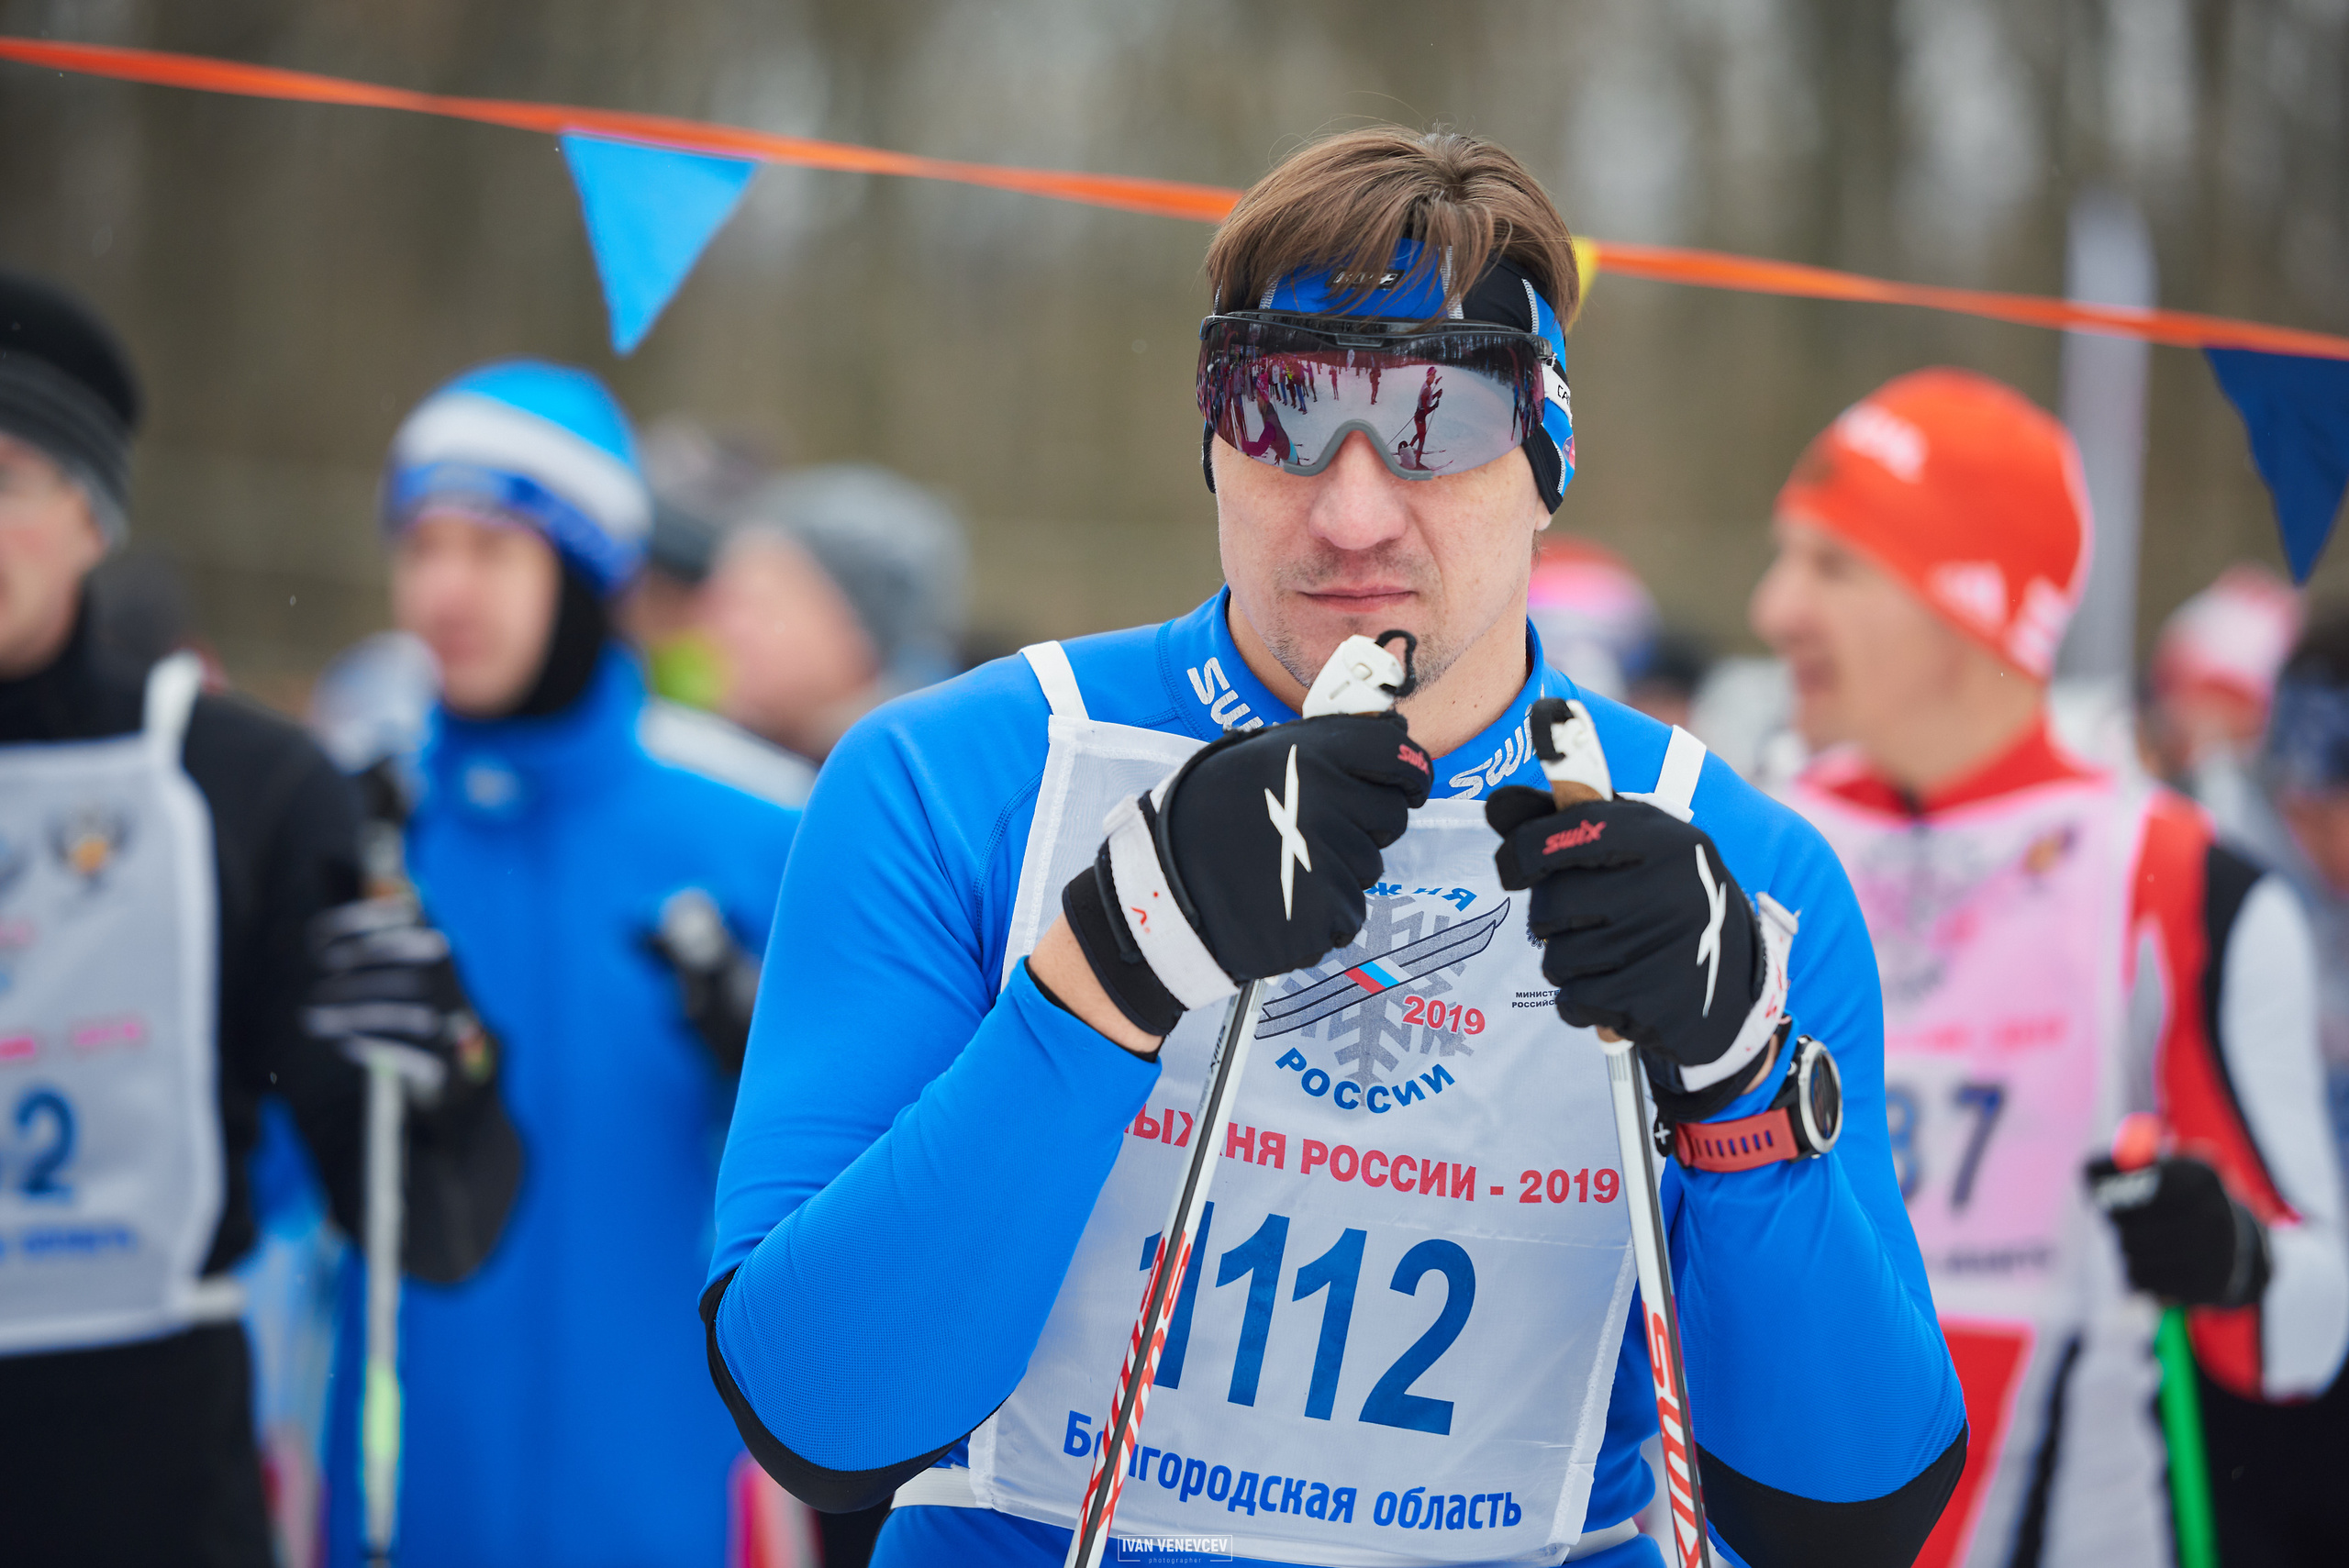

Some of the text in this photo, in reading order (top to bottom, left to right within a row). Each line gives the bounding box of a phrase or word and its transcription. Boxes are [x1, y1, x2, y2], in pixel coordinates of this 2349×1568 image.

[1364, 882, 1476, 912] ЖНЯ
[1402, 995, 1486, 1035] 2019
[1511, 999, 1555, 1008] РОССИЙС
[1275, 1048, 1455, 1114] РОССИИ
[1301, 1139, 1476, 1202] РОССИИ
[1520, 1169, 1620, 1204] 2019
[1140, 1201, 1476, 1436] 1112
[1374, 1490, 1522, 1530] область
